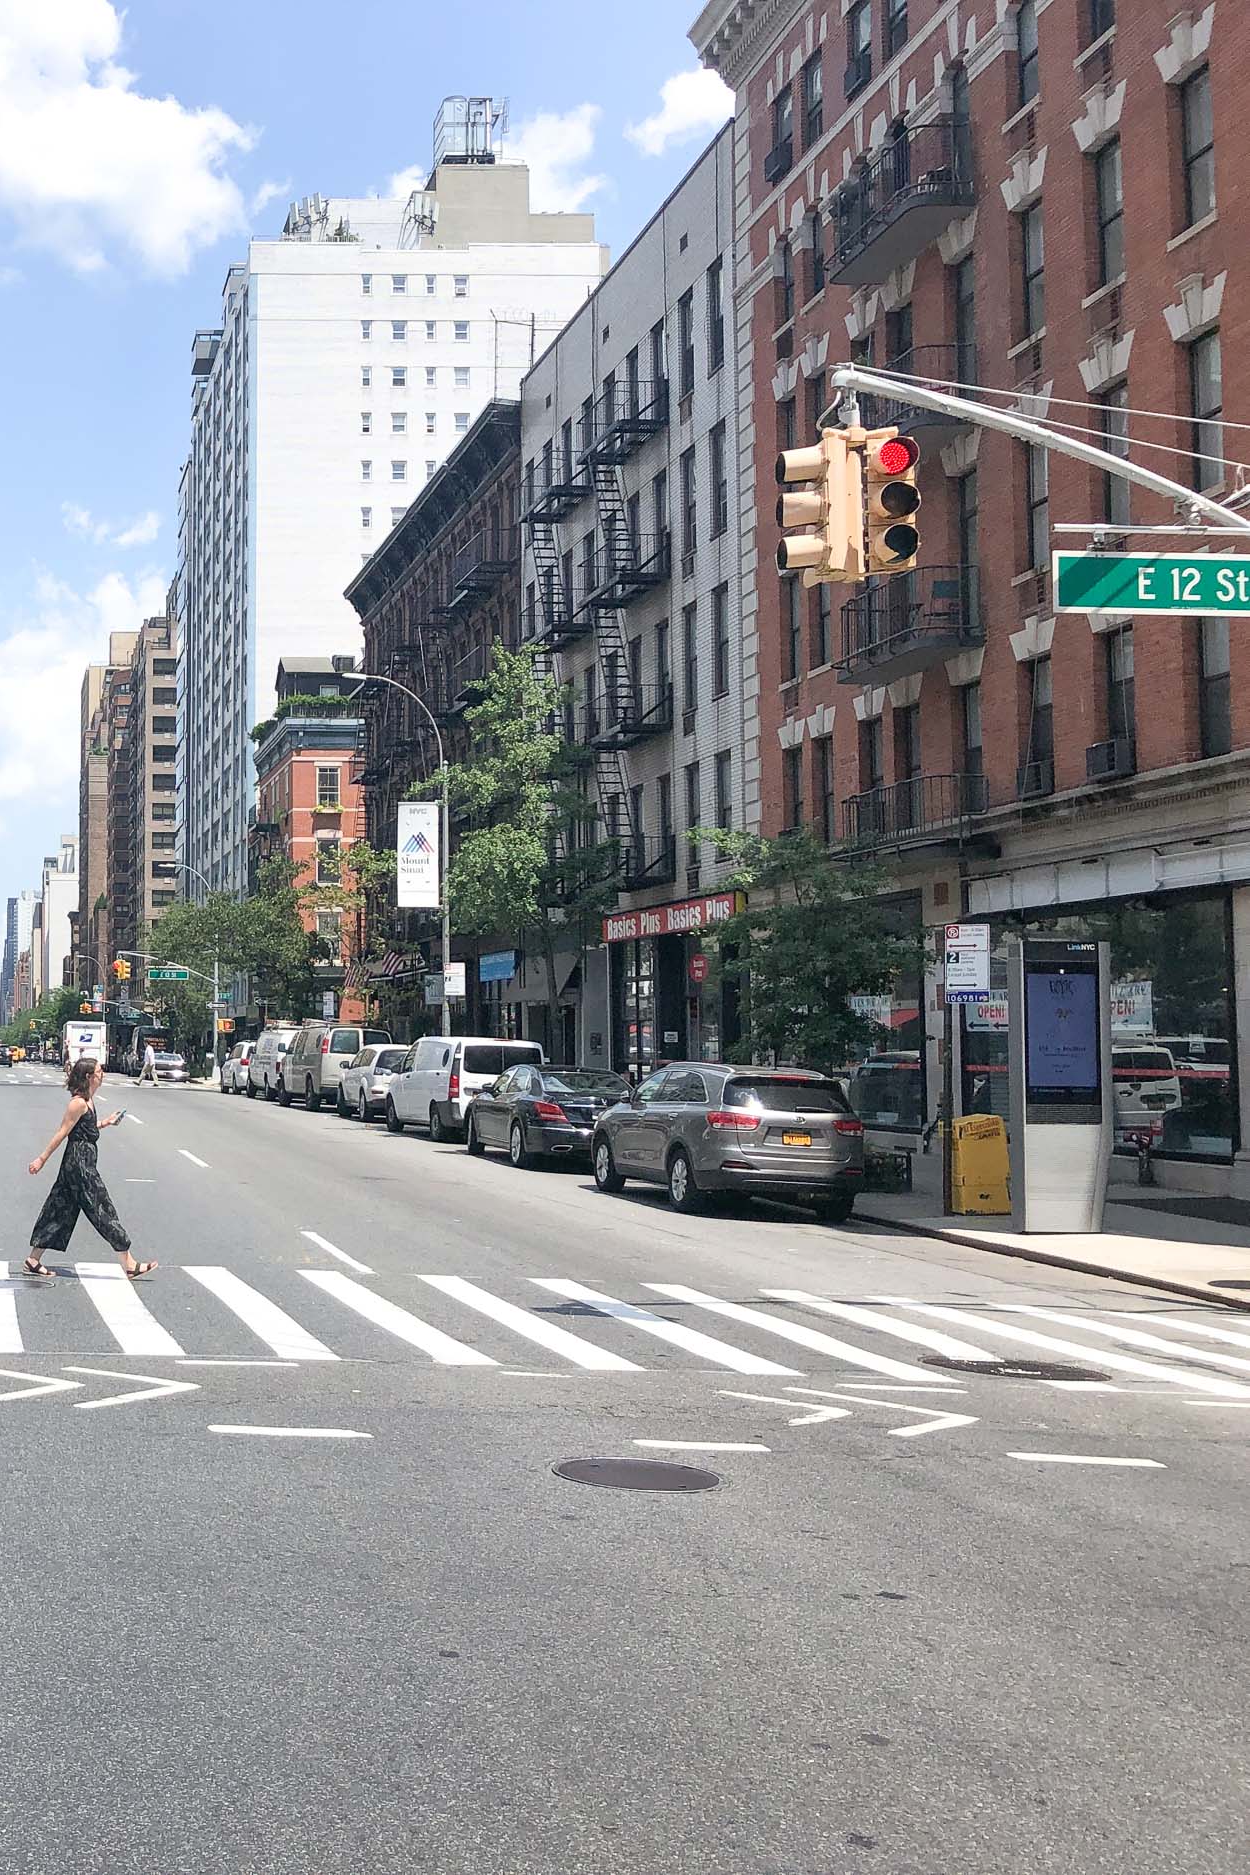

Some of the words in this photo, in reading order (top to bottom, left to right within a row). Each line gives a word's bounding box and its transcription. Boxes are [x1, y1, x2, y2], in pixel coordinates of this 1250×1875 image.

[1138, 567, 1156, 600] E
[1170, 567, 1202, 601] 12
[1216, 568, 1250, 602] St
[400, 856, 430, 865] Mount
[400, 866, 424, 874] Sinai
[607, 916, 637, 940] Basics
[640, 912, 661, 935] Plus
[667, 904, 702, 930] Basics
[705, 899, 730, 924] Plus
[949, 952, 957, 963] 2
[947, 994, 978, 1002] 106981
[977, 1004, 1006, 1018] OPEN!
